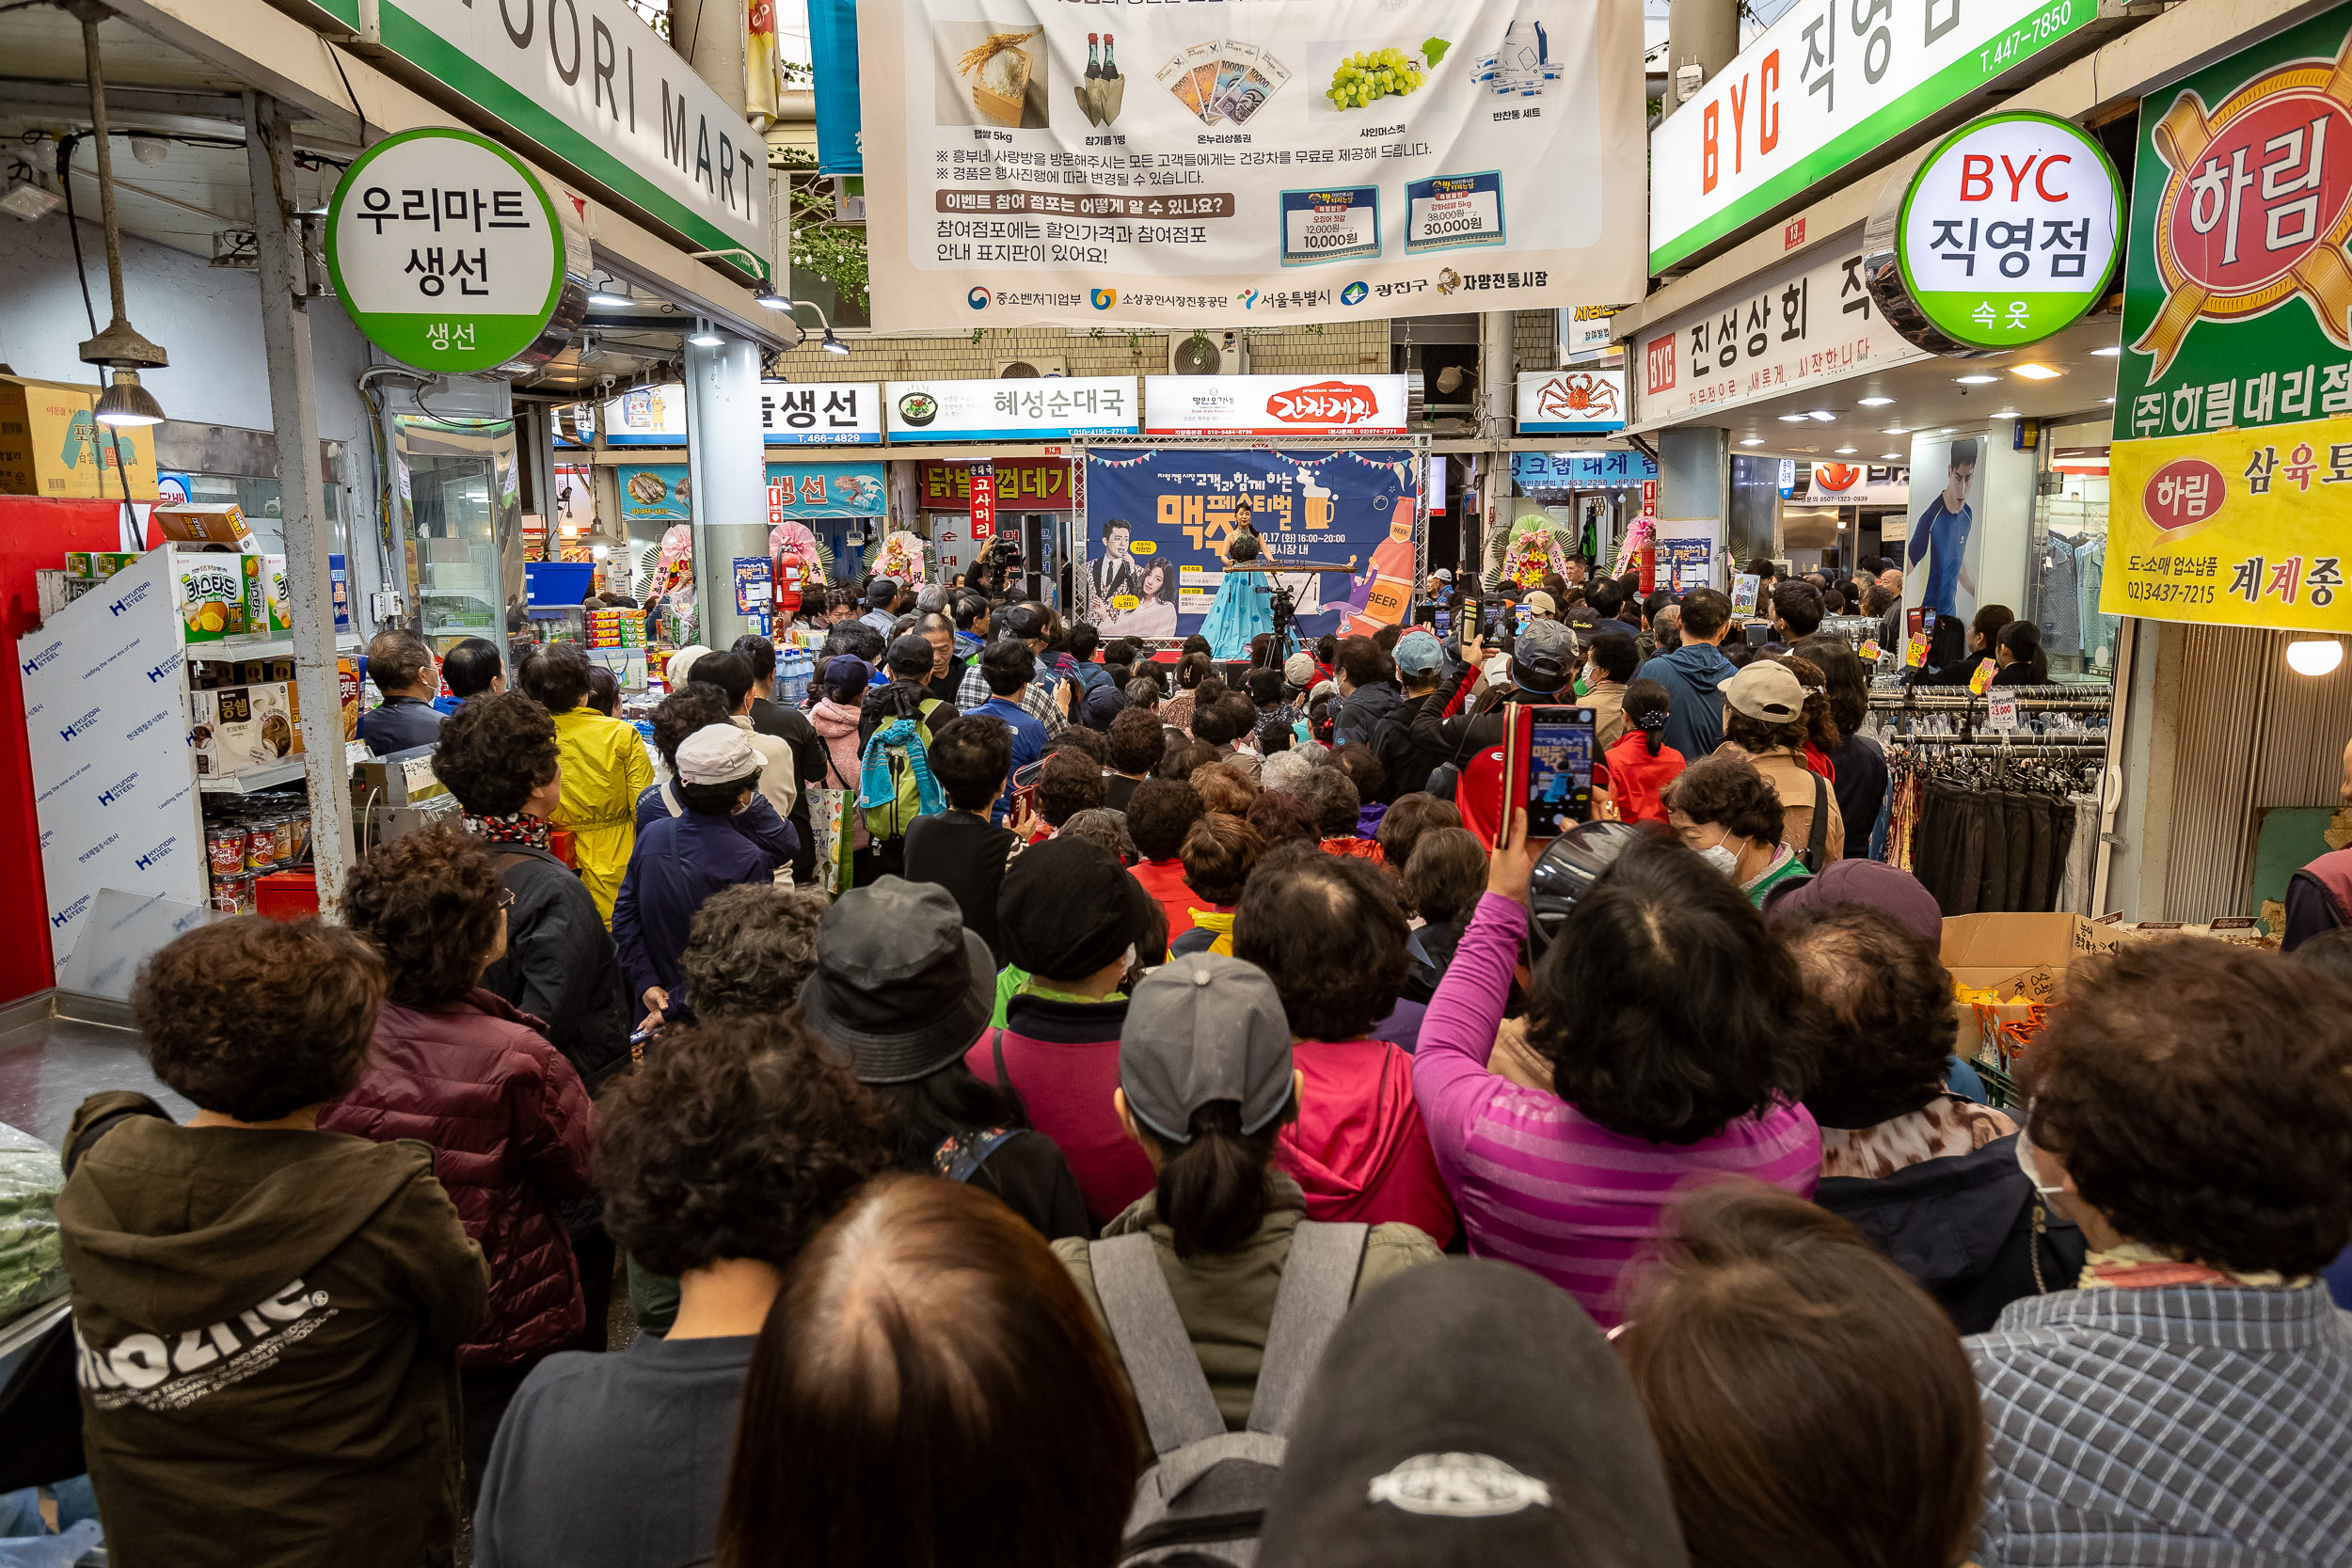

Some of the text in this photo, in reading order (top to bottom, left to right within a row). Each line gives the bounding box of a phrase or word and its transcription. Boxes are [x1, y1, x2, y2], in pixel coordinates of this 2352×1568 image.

[1979, 2, 2072, 74] T.447-7850
[1221, 60, 1245, 73] 10000
[463, 0, 755, 222] OORI MART
[1493, 107, 1541, 123] 반찬통 세트
[1359, 124, 1406, 138] 샤인머스켓
[1702, 49, 1780, 197] BYC
[974, 129, 1013, 143] 햅쌀 5kg
[1085, 135, 1126, 146] 참기름 1병
[1197, 134, 1252, 145] 온누리상품권
[953, 143, 1433, 169] 흥부네 사랑방을 방문해주시는 모든 고객들에게는 건강차를 무료로 제공해 드립니다.
[953, 166, 1204, 186] 경품은 행사진행에 따라 변경될 수 있습니다.
[1960, 154, 2073, 202] BYC
[2190, 111, 2334, 268] 하림
[356, 186, 531, 234] 우리마트
[946, 194, 1223, 215] 이벤트 참여 점포는 어떻게 알 수 있나요?
[1457, 200, 1472, 210] 5kg
[1423, 217, 1483, 235] 30,000원
[1426, 209, 1465, 222] 38,000원
[937, 221, 1207, 244] 참여점포에는 할인가격과 참여점포
[1305, 224, 1340, 234] 12,000원
[1790, 224, 1799, 242] 13
[1303, 232, 1358, 248] 10,000원
[1930, 217, 2091, 278] 직영점
[937, 244, 1107, 264] 안내 표지판이 있어요!
[404, 246, 489, 296] 생선
[1463, 271, 1549, 292] 자양전통시장
[1375, 278, 1429, 296] 광진구
[995, 292, 1082, 307] 중소벤처기업부
[1122, 293, 1228, 309] 소상공인시장진흥공단
[1261, 288, 1331, 309] 서울특별시
[425, 323, 476, 351] 생선
[1584, 327, 1610, 341] 참여방법
[1649, 343, 1674, 389] BYC
[1691, 277, 1809, 378] 진성상회
[993, 388, 1125, 420] 혜성순대국
[1272, 395, 1371, 424] 간장게장
[797, 434, 861, 444] T.466-4829
[970, 464, 993, 476] 순대국
[1582, 453, 1628, 475] 대게
[994, 467, 1073, 500] 껍데기
[1196, 473, 1234, 492] 고객과
[1233, 471, 1265, 491] 함께
[1266, 471, 1293, 493] 하는
[2157, 473, 2209, 516] 하림
[975, 478, 992, 536] 고사머리
[1297, 532, 1346, 544] 16:00~20:00
[1393, 527, 1408, 536] BEER
[1298, 544, 1309, 555] 내
[2127, 555, 2218, 578] 도·소매 업소납품
[122, 581, 151, 604] HYUNDAI
[186, 575, 236, 599] 카스타드
[2127, 581, 2216, 605] 02)3437-7215
[126, 593, 149, 609] STEEL
[1368, 592, 1398, 610] BEER
[34, 641, 63, 662] HYUNDAI
[39, 651, 60, 668] STEEL
[82, 664, 101, 680] Leading
[99, 659, 108, 669] the
[107, 654, 118, 663] new
[117, 648, 125, 657] era
[129, 638, 141, 649] steel
[72, 706, 102, 728] HYUNDAI
[220, 698, 248, 719] 몽쉘
[76, 718, 98, 734] STEEL
[126, 709, 169, 741] 현대제철주식회사
[51, 783, 60, 792] the
[58, 777, 69, 788] new
[68, 773, 77, 782] era
[80, 763, 91, 772] steel
[110, 771, 139, 793] HYUNDAI
[114, 783, 135, 799] STEEL
[158, 790, 184, 810] Leading the
[78, 832, 120, 864] 현대제철주식회사
[147, 835, 177, 857] HYUNDAI
[151, 847, 173, 863] STEEL
[62, 894, 91, 915] HYUNDAI
[67, 905, 87, 921] STEEL
